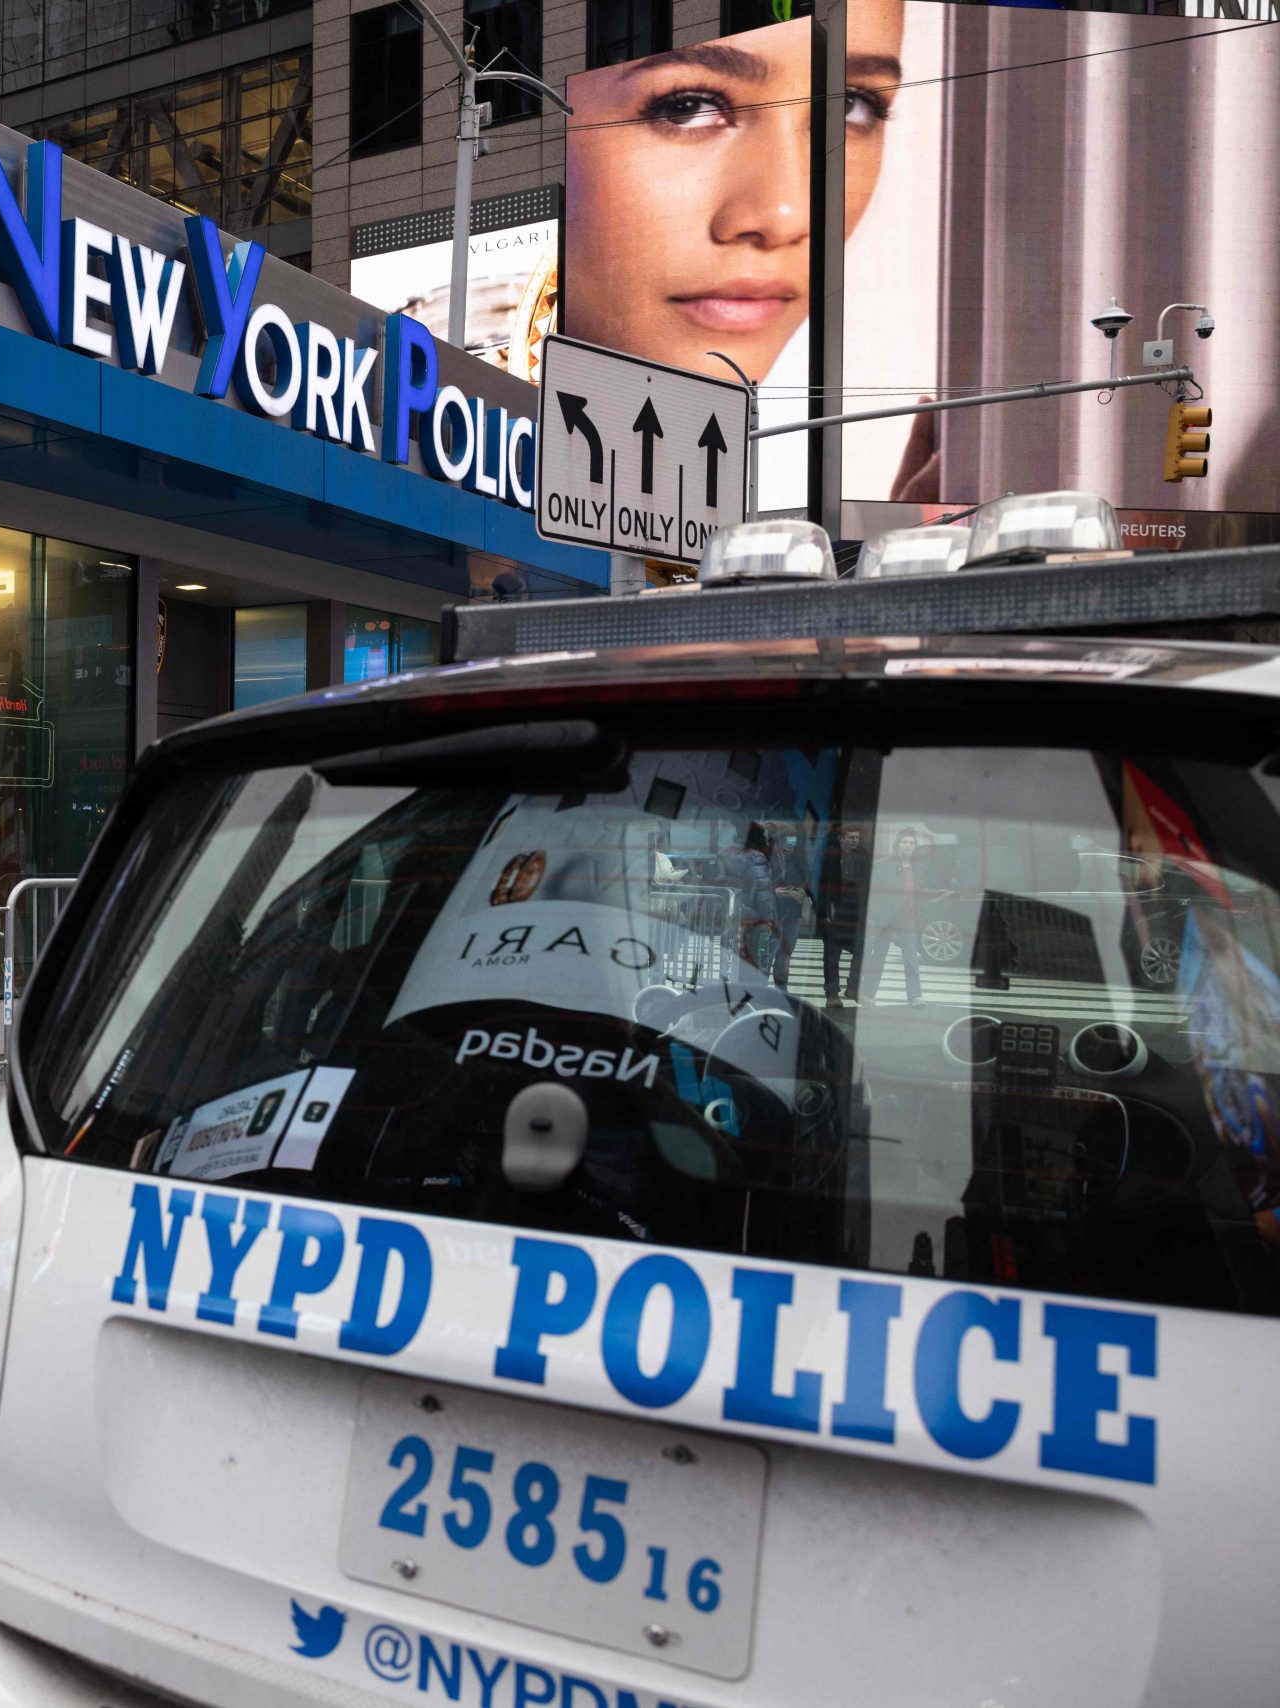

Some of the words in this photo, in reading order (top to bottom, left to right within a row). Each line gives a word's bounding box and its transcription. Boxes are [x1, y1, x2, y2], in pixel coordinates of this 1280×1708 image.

[469, 229, 550, 255] VLGARI
[184, 214, 379, 453] YORK
[382, 313, 537, 511] POLIC
[548, 492, 607, 530] ONLY
[618, 507, 674, 543] ONLY
[684, 520, 718, 550] ON
[1120, 523, 1187, 538] REUTERS
[4, 959, 12, 1021] NYPD
[111, 1182, 434, 1357] NYPD
[493, 1236, 1158, 1485] POLICE
[378, 1435, 629, 1584] 2585
[643, 1546, 722, 1614] 16
